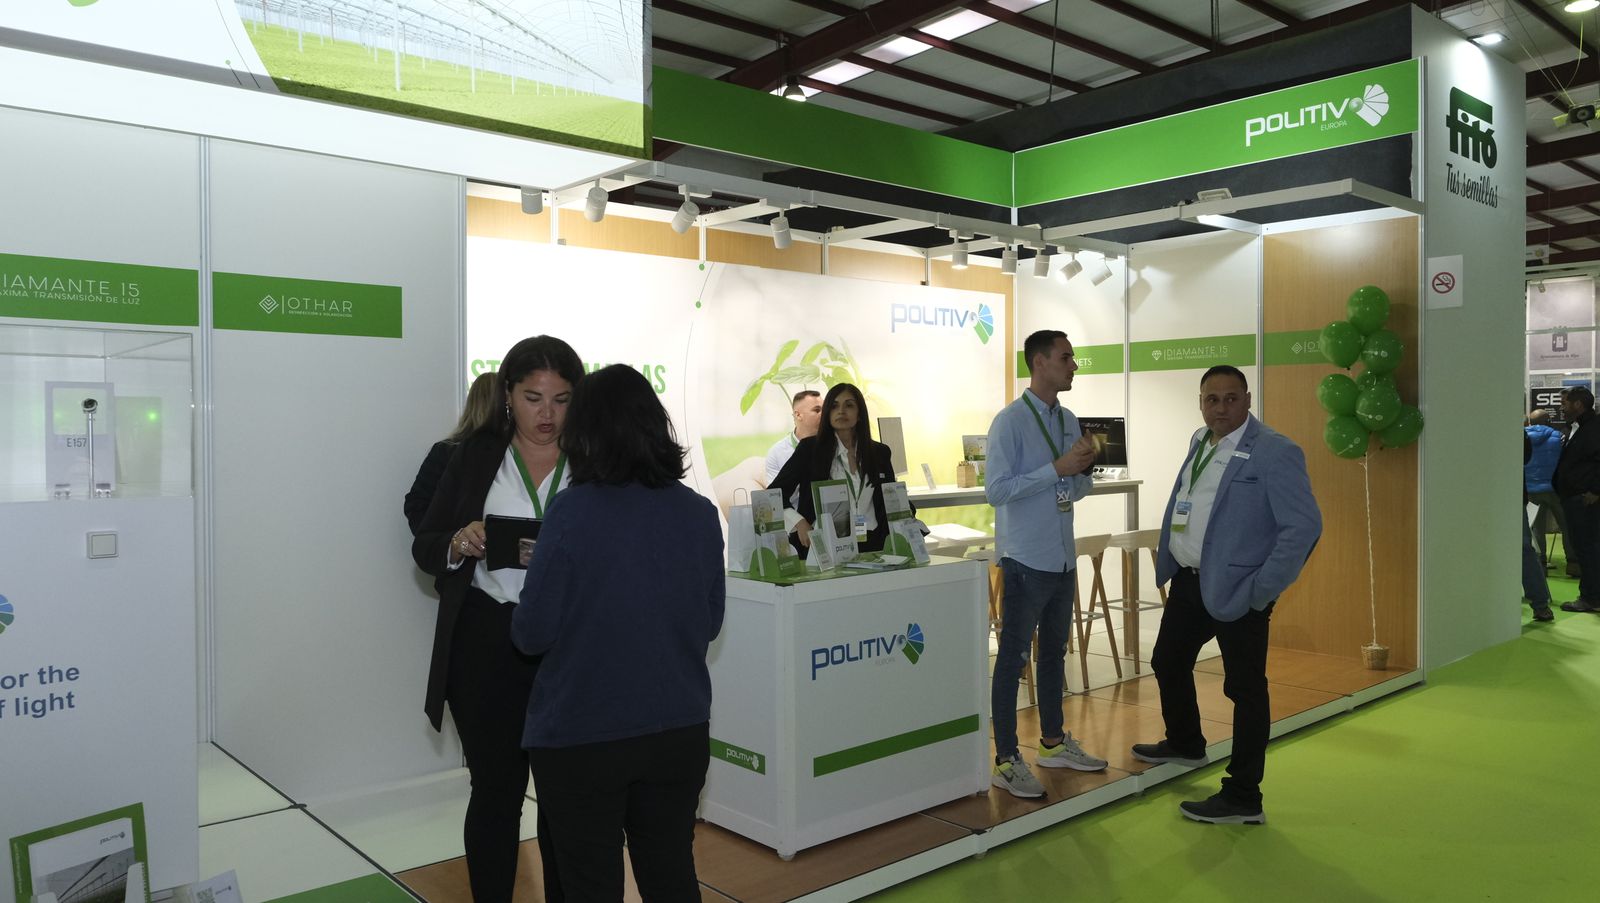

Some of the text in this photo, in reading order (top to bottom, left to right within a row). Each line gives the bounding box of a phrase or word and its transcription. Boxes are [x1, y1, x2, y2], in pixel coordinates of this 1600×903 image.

[1320, 120, 1348, 132] EUROPA
[1446, 86, 1497, 169] fitó
[1446, 162, 1498, 209] Tus semillas
[33, 290, 102, 303] TRANSMISIÓN
[106, 296, 118, 304] DE
[122, 297, 140, 305] LUZ
[121, 282, 140, 298] 15
[287, 297, 353, 313] OTHAR
[1167, 345, 1216, 357] DIAMANTE
[37, 665, 80, 685] the
[15, 691, 75, 719] light
